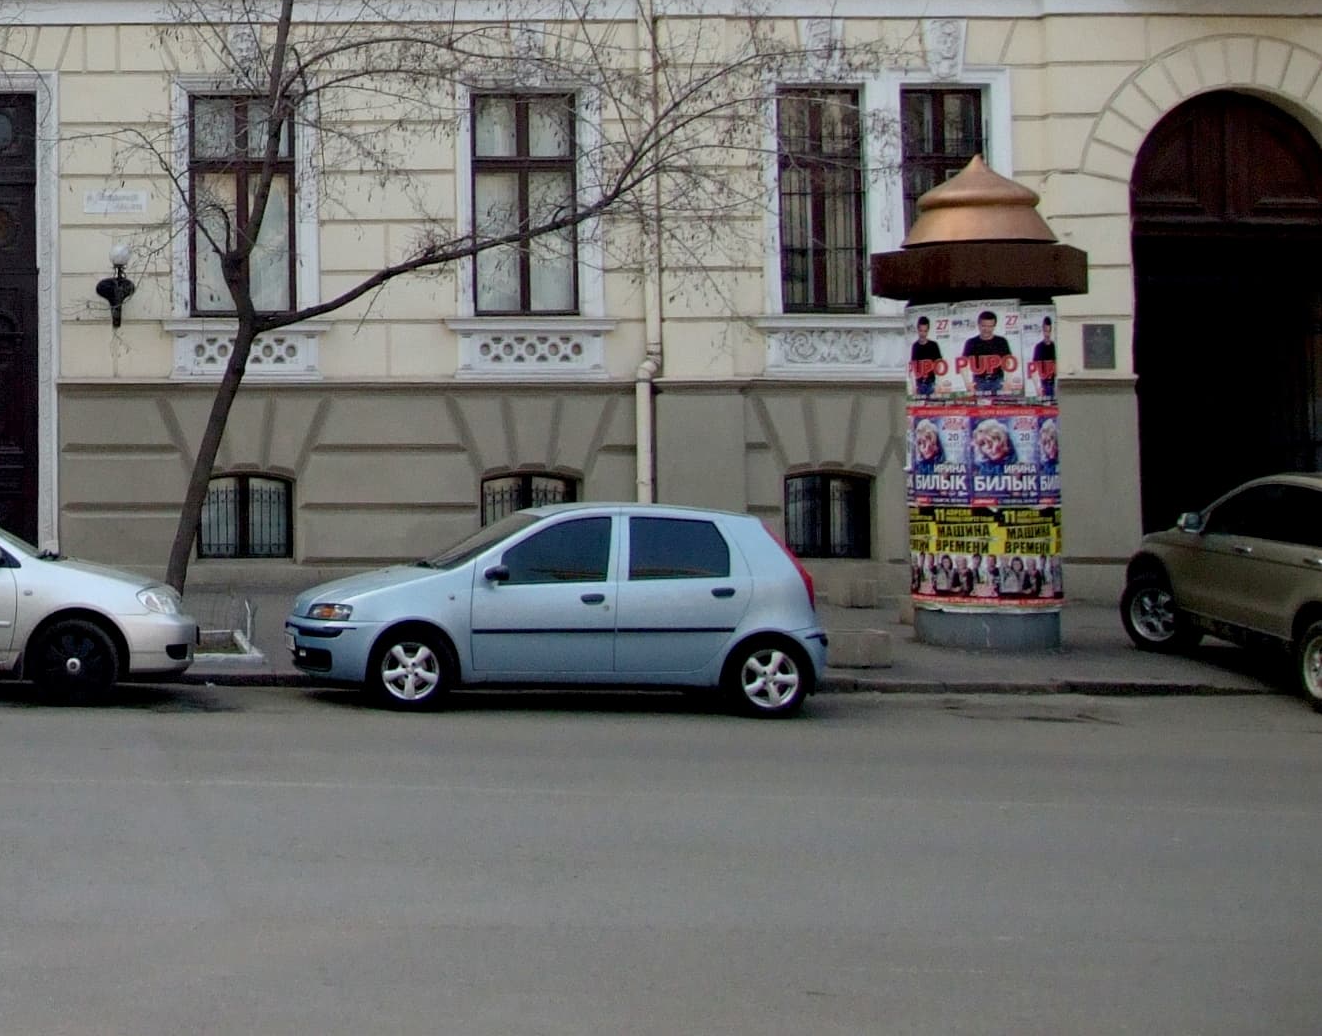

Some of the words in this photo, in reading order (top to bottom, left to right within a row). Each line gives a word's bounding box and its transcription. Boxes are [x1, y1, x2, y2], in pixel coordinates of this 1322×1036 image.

[935, 319, 949, 330] 27
[1005, 315, 1019, 326] 27
[955, 355, 1018, 375] PUPO
[948, 432, 959, 442] 20
[1020, 432, 1031, 442] 20
[1004, 464, 1037, 474] ИРИНА
[915, 475, 967, 490] БИЛЫК
[974, 475, 1038, 491] БИЛЫК
[937, 524, 991, 537] МАШИНА
[935, 540, 990, 554] ВРЕМЕНИ
